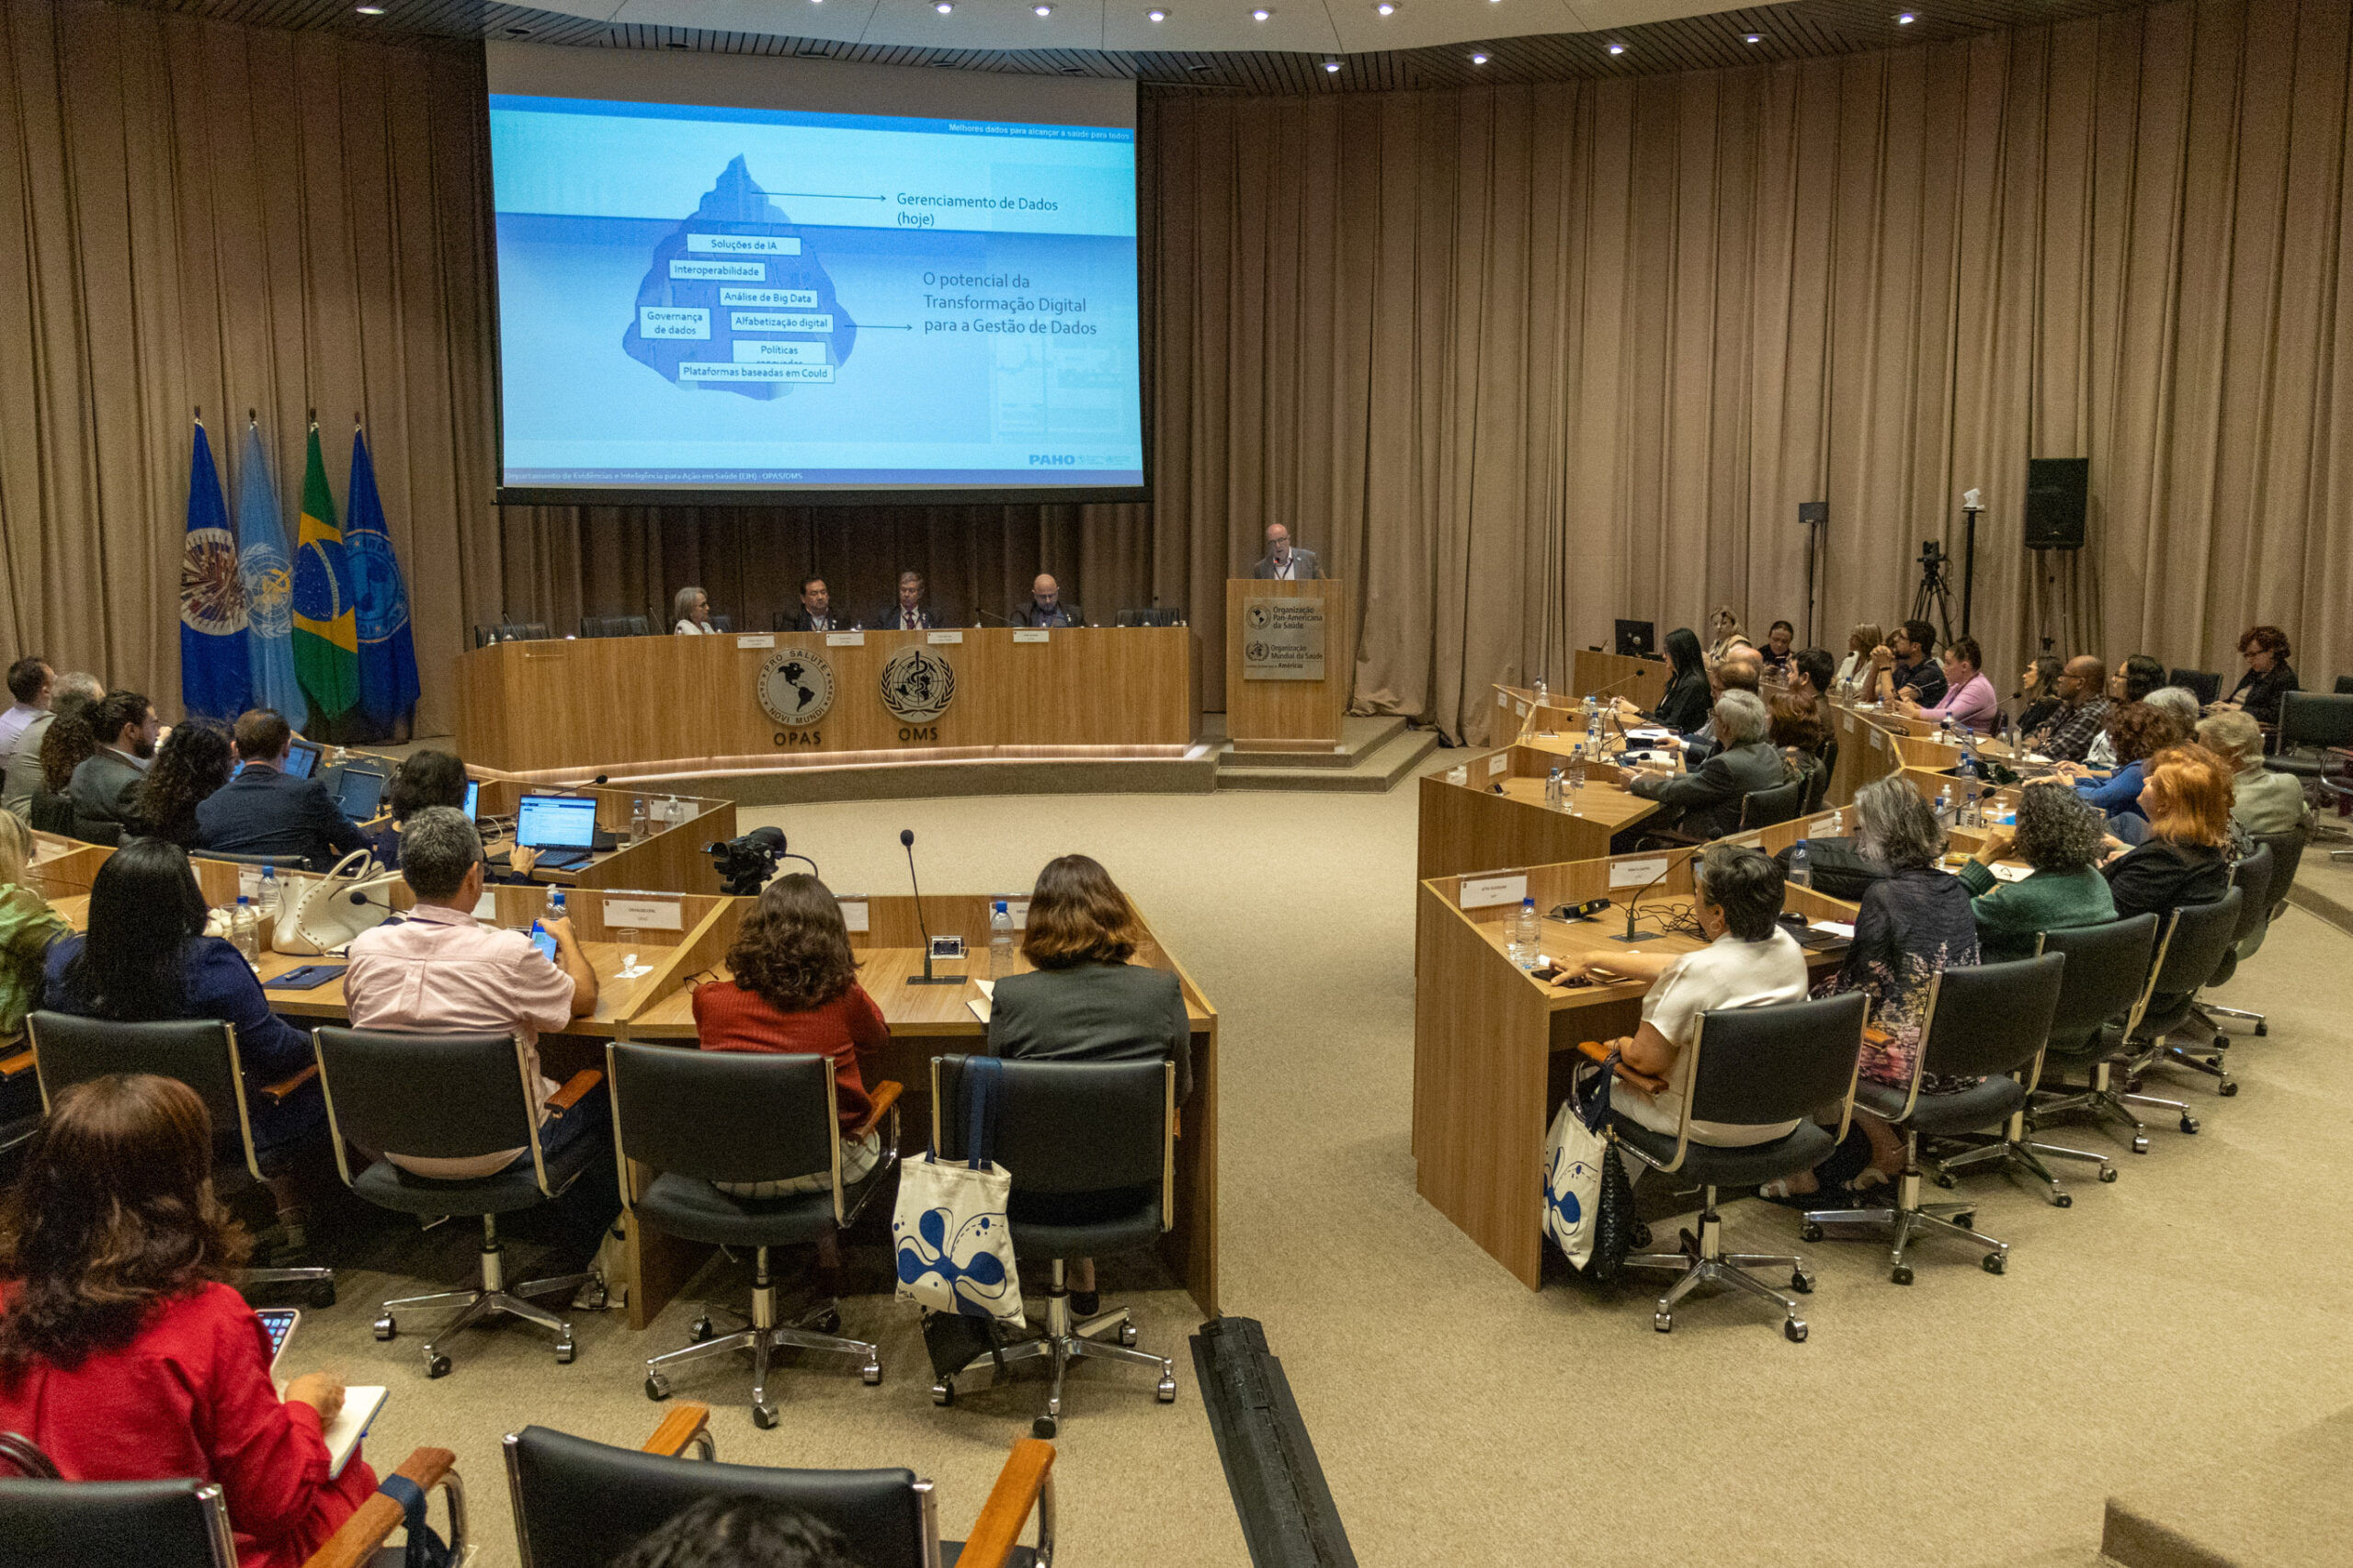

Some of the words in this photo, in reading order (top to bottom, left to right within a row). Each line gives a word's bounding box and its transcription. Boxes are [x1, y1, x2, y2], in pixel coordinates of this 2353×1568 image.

[949, 123, 983, 133] Melhores
[985, 125, 1008, 134] dados
[1010, 127, 1028, 136] para
[1029, 127, 1060, 138] alcançar
[1067, 130, 1088, 138] saúde
[1090, 131, 1108, 140] para
[1108, 131, 1131, 141] todos
[897, 192, 996, 210] Gerenciamento
[999, 197, 1015, 210] de
[1018, 198, 1059, 211] Dados
[897, 210, 935, 228] (hoje)
[710, 238, 752, 252] Soluções
[754, 240, 765, 250] de
[767, 240, 778, 250] IA
[674, 265, 759, 277] Interoperabilidade
[923, 272, 935, 286] O
[940, 274, 1008, 290] potencial
[1012, 274, 1030, 289] da
[724, 291, 757, 302] Análise
[759, 293, 771, 302] de
[773, 292, 788, 305] Big
[790, 293, 812, 303] Data
[923, 294, 1035, 314] Transformação
[1039, 298, 1086, 316] Digital
[647, 311, 703, 323] Governança
[735, 317, 798, 329] Alfabetização
[800, 318, 827, 330] digital
[654, 325, 666, 335] de
[668, 325, 697, 335] dados
[924, 320, 958, 335] para
[961, 322, 970, 332] a
[973, 318, 1025, 334] Gestão
[1029, 319, 1047, 334] de
[1051, 320, 1097, 335] Dados
[760, 345, 799, 355] Políticas
[683, 367, 739, 378] Plataformas
[741, 368, 783, 379] baseadas
[786, 370, 800, 379] em
[801, 369, 827, 379] Could
[1029, 454, 1075, 466] PAHO
[563, 472, 573, 480] de
[574, 471, 613, 480] Evidências
[665, 473, 683, 482] para
[682, 472, 701, 482] Ação
[715, 472, 737, 481] Saúde
[762, 472, 803, 481] OPAS/OMS
[764, 653, 783, 673] PRO
[789, 650, 828, 672] SALUTE
[768, 707, 790, 724] NOVI
[795, 706, 824, 724] MUNDI
[773, 731, 822, 746] OPAS
[898, 726, 938, 742] OMS
